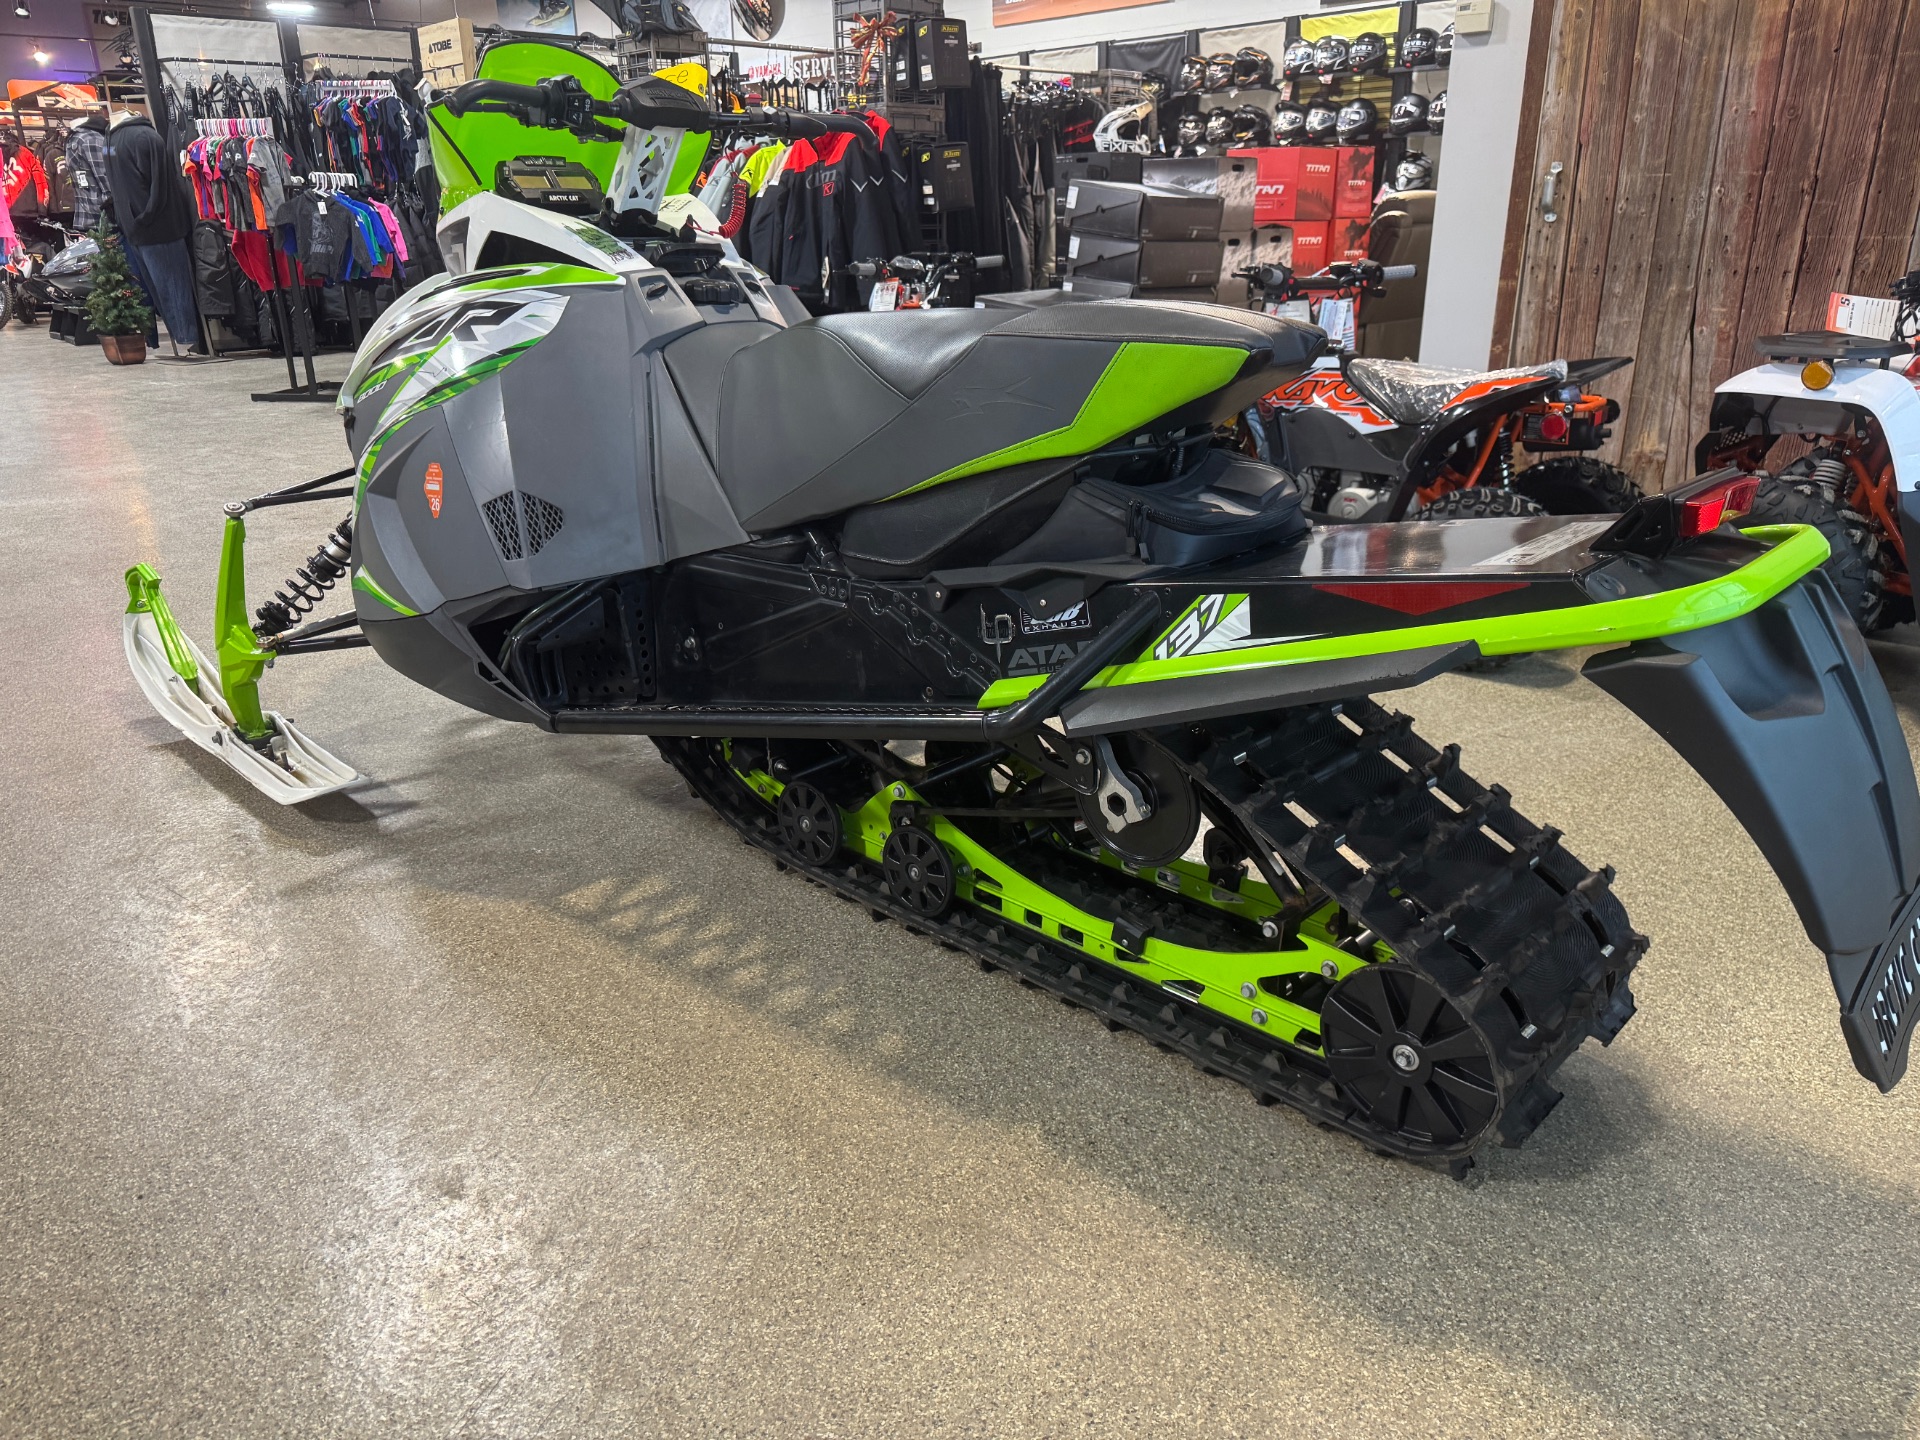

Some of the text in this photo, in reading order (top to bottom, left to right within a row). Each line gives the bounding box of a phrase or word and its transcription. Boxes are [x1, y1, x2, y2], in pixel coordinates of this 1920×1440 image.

[432, 39, 452, 52] TOBE
[755, 63, 782, 78] YAMAHA
[1306, 163, 1331, 173] TITAN
[1347, 179, 1366, 187] TITAN
[1297, 236, 1323, 245] TITAN
[1343, 249, 1364, 257] TITAN
[431, 497, 440, 511] 26
[1024, 619, 1087, 632] EXHAUST
[1155, 593, 1225, 661] 137
[1872, 941, 1916, 1060] ARCTIC
